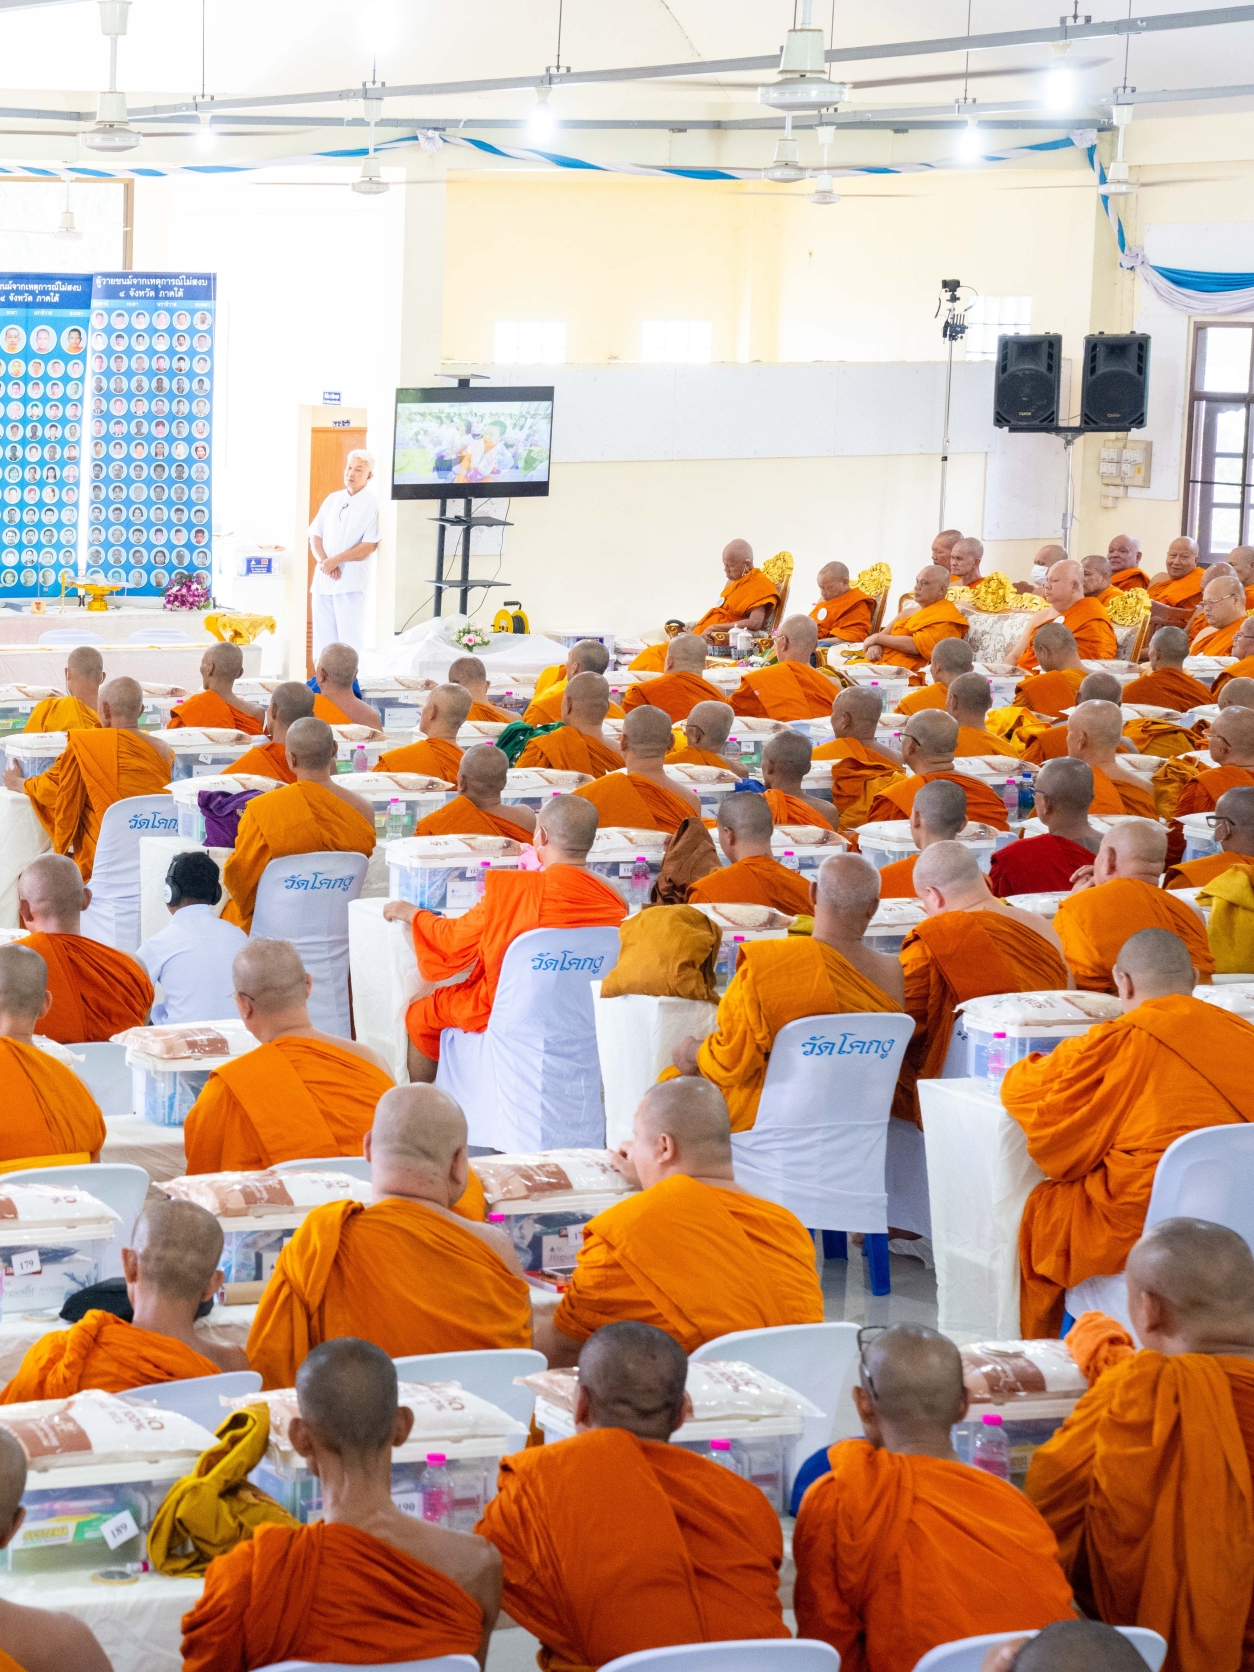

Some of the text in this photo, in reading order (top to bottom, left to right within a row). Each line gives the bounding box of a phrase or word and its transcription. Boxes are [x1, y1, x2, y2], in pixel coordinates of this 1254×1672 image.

[284, 871, 355, 892] วัดโคกงู
[531, 950, 605, 975] วัดโคกงู
[801, 1032, 895, 1059] วัดโคกงู
[19, 1259, 34, 1270] 179
[109, 1522, 129, 1540] 189
